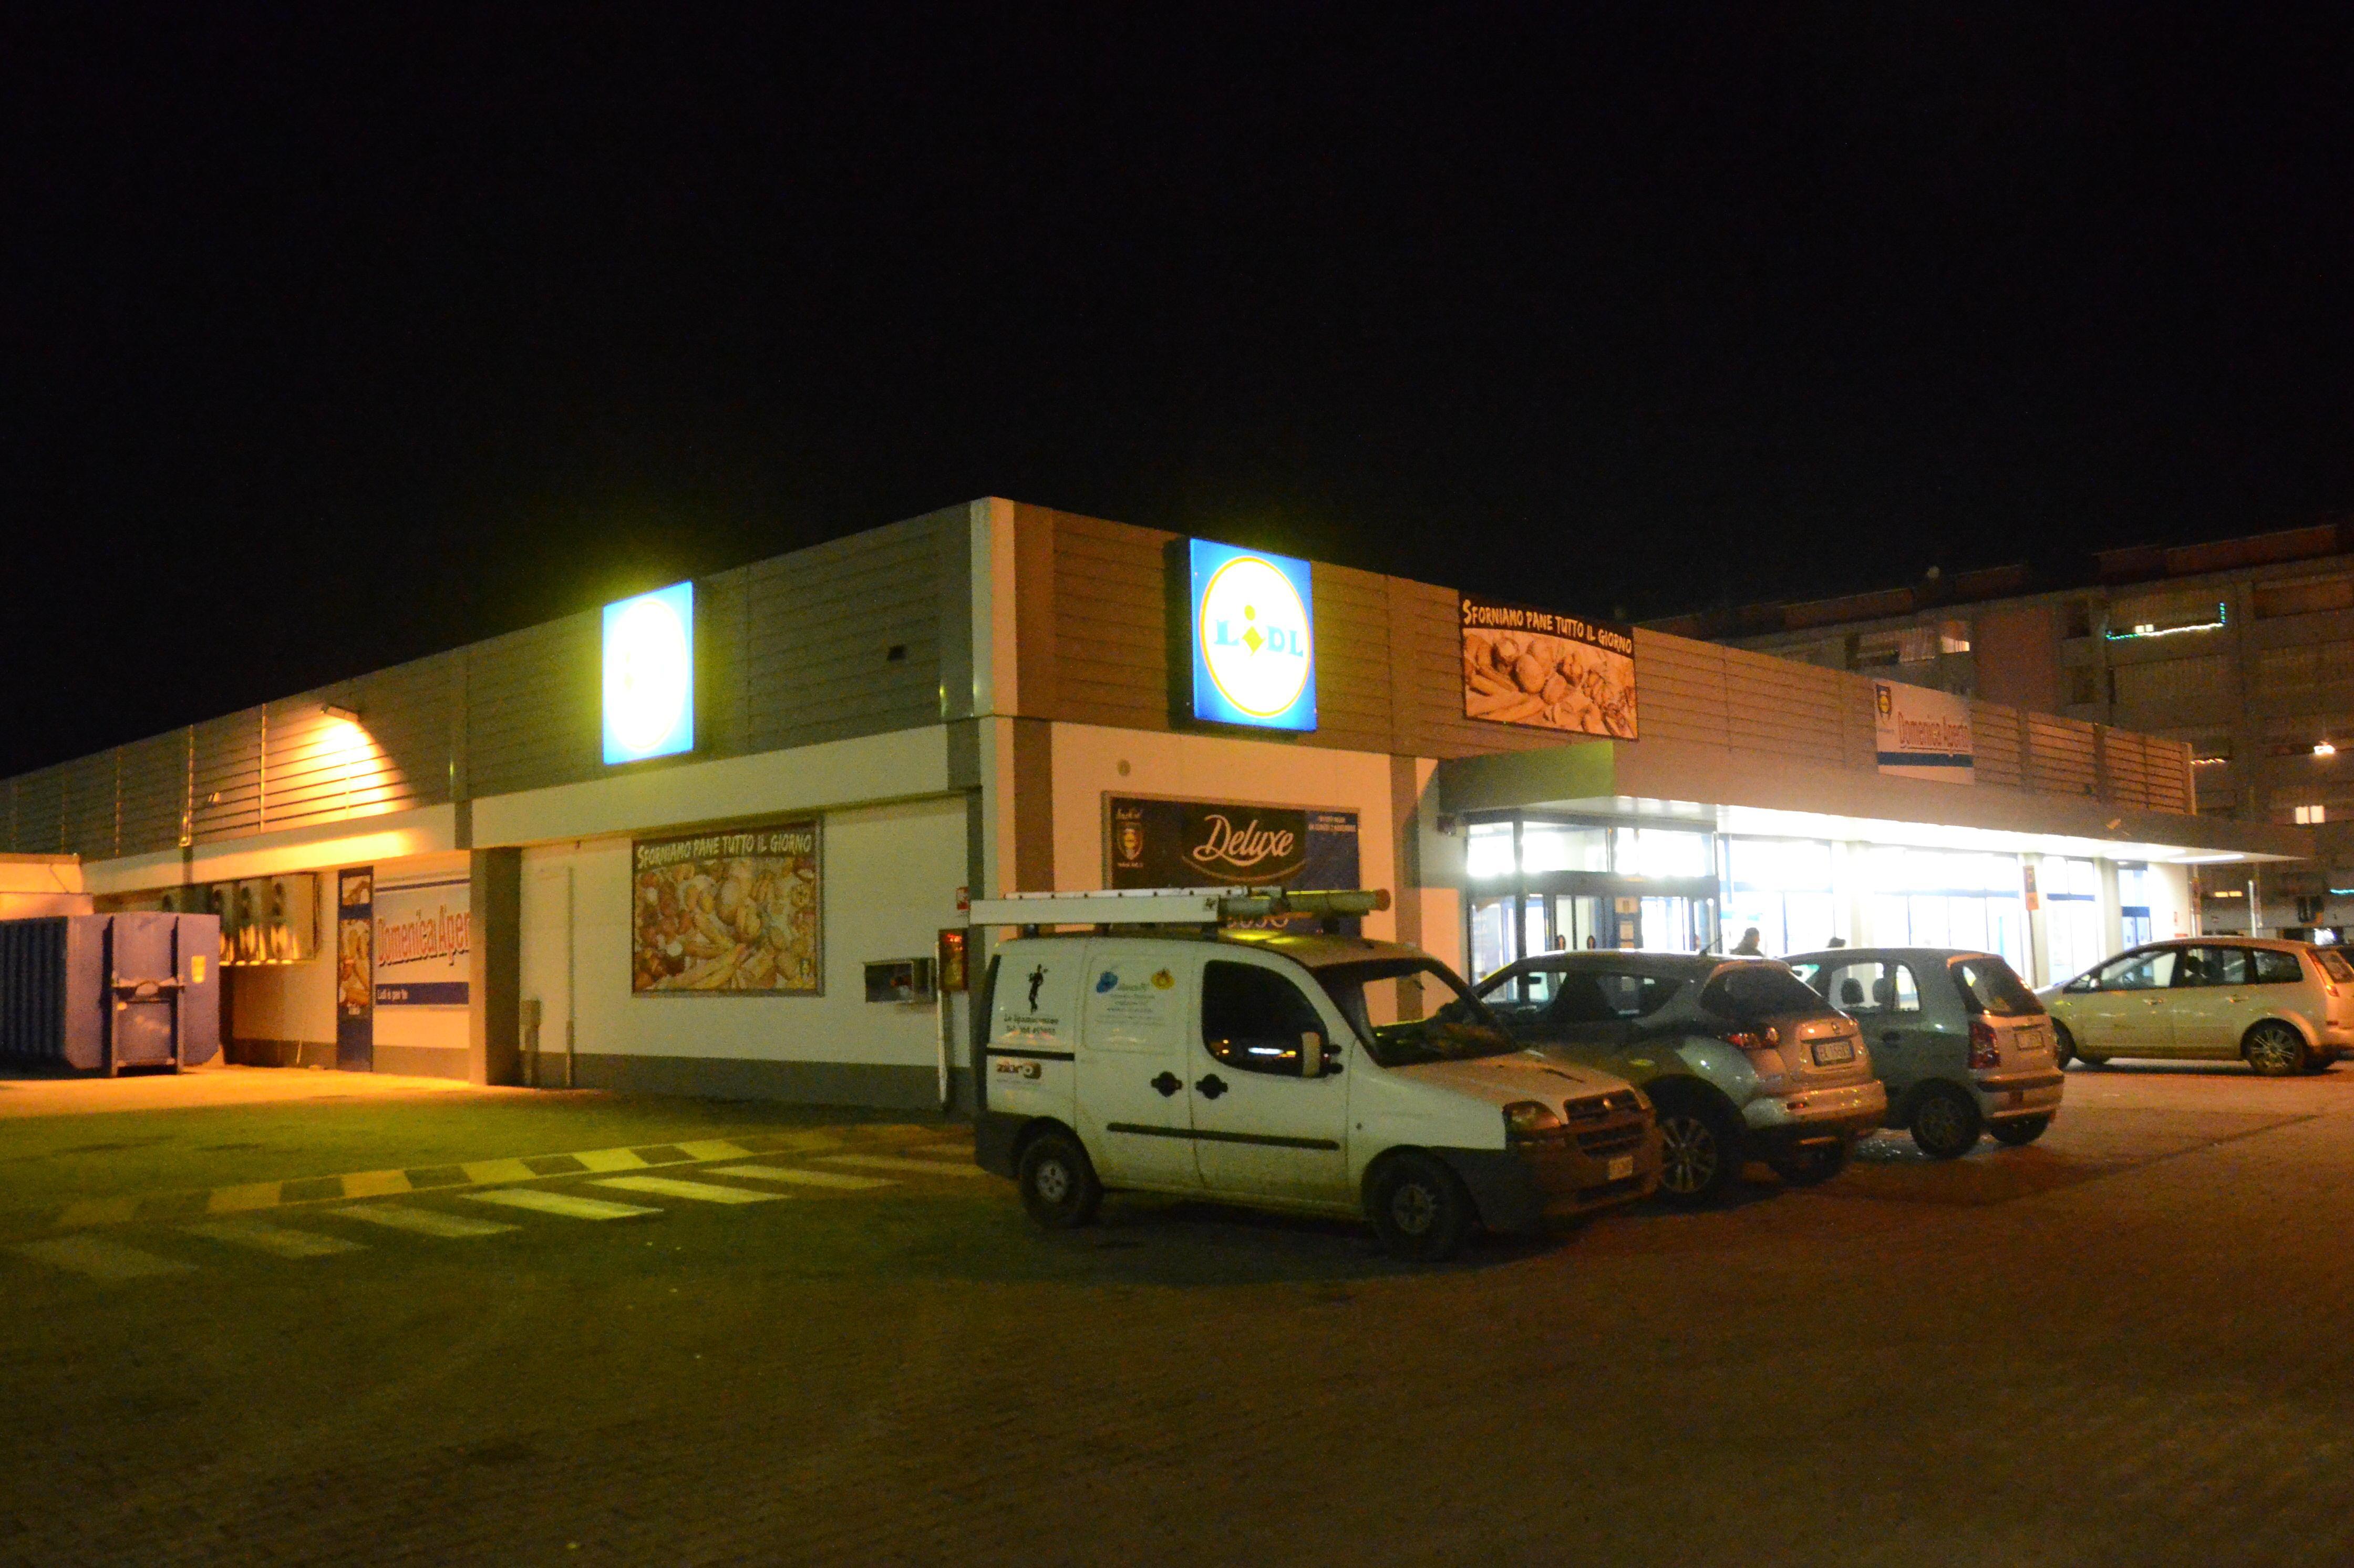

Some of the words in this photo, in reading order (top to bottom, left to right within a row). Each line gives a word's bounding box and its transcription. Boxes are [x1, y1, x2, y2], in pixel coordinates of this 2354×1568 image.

[1526, 611, 1553, 631] PANE
[1555, 616, 1584, 638] TUTTO
[694, 837, 719, 856] PANE
[722, 834, 753, 854] TUTTO
[1193, 814, 1294, 866] Deluxe
[439, 905, 470, 966] Aper
